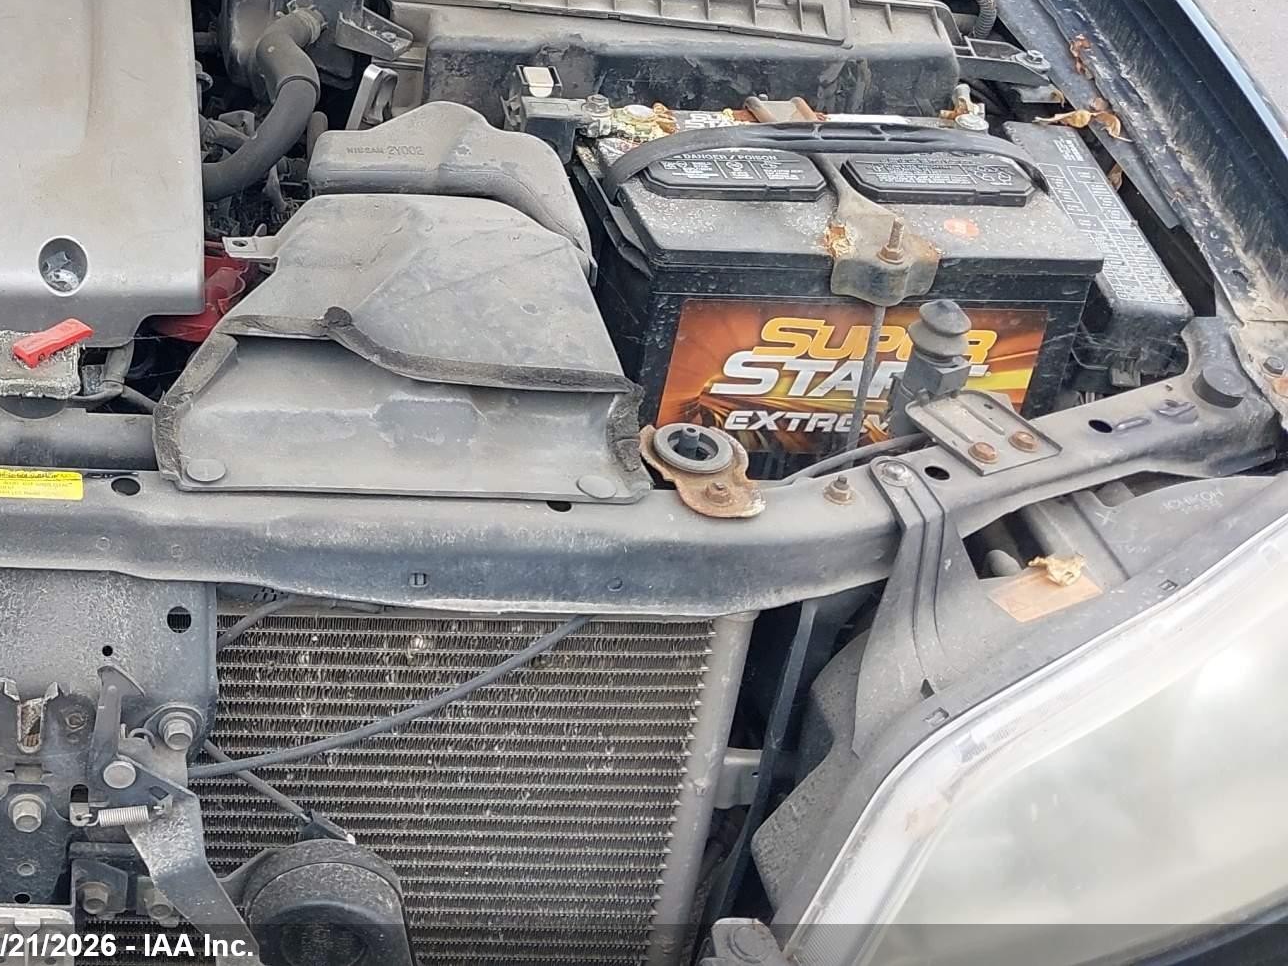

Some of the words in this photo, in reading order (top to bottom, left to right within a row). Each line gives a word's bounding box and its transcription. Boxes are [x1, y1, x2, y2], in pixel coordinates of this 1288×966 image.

[345, 145, 384, 155] NISSAN
[386, 145, 425, 156] 2Y002
[682, 153, 728, 161] DANGER
[737, 154, 777, 162] POISON
[710, 351, 990, 398] STA
